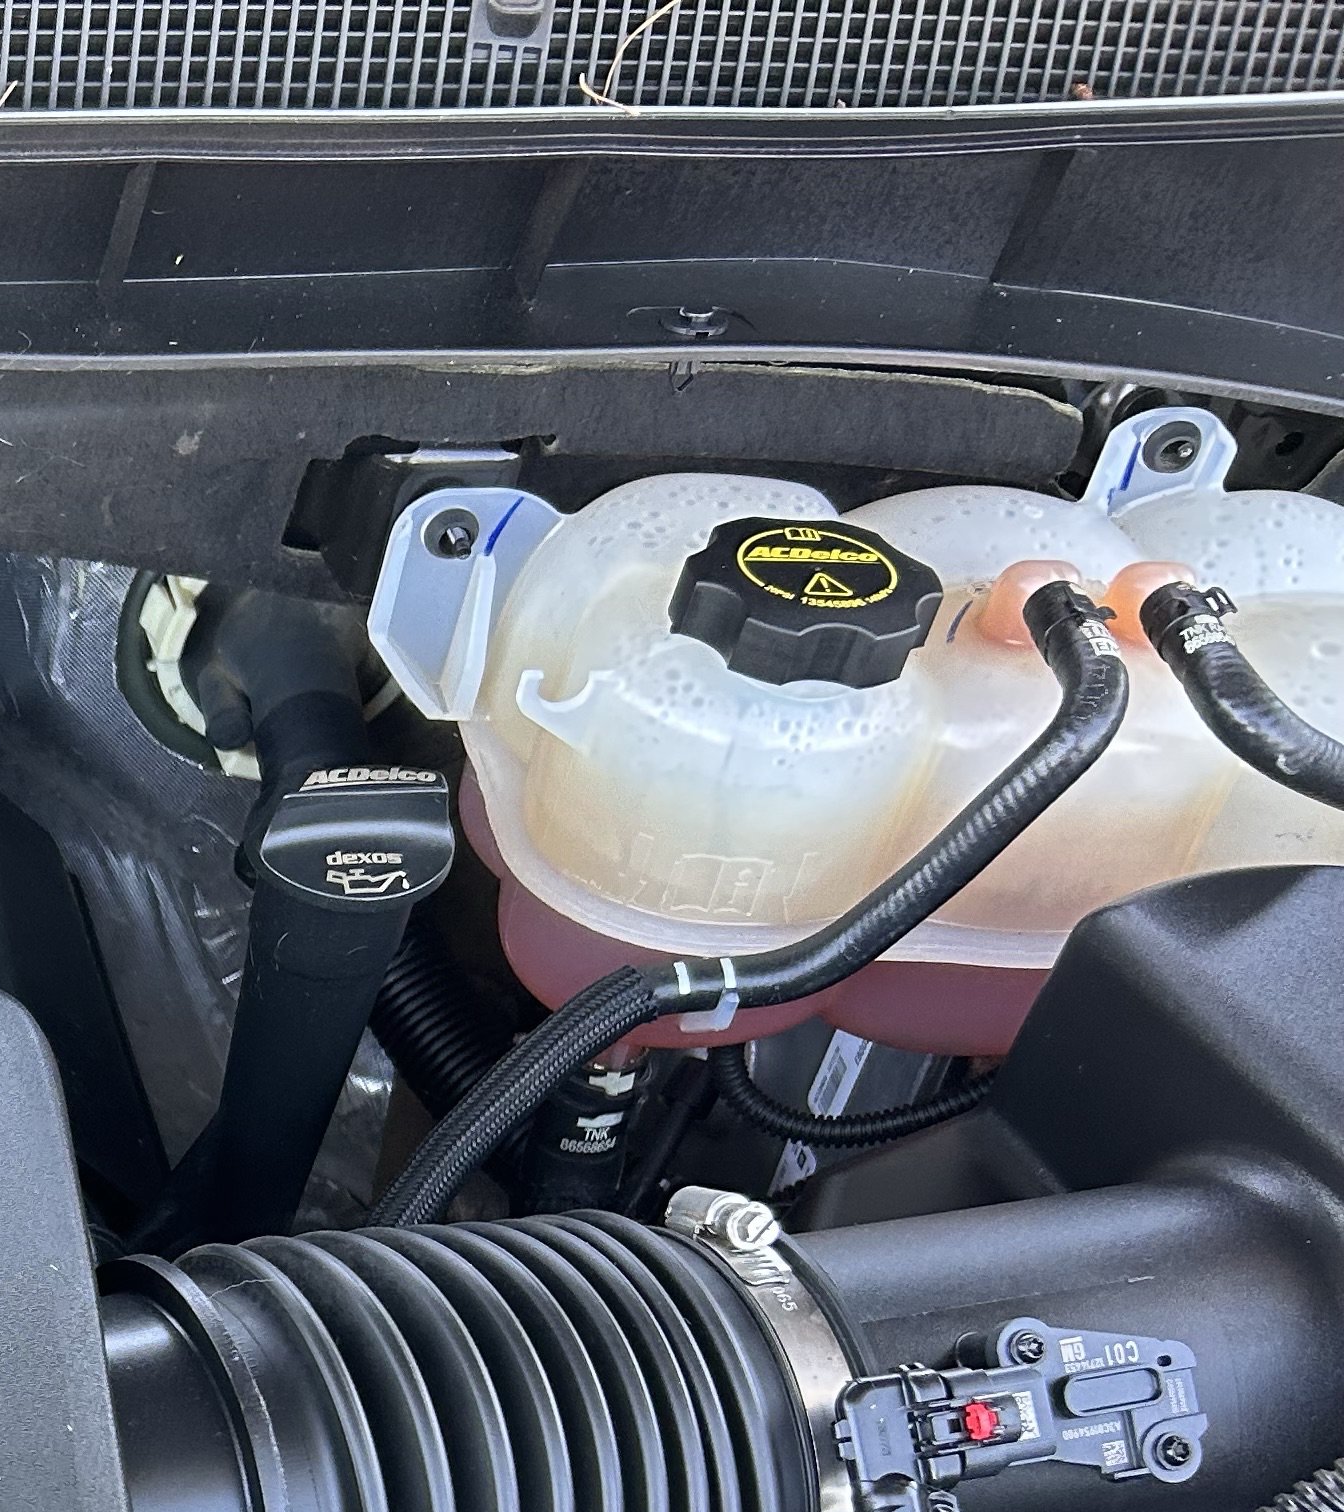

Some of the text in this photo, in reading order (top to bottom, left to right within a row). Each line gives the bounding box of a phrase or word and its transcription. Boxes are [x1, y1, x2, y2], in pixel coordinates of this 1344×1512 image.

[747, 546, 879, 562] ACDelco
[304, 767, 437, 786] ACDelco
[326, 851, 403, 866] dexos
[585, 1127, 611, 1141] TNK
